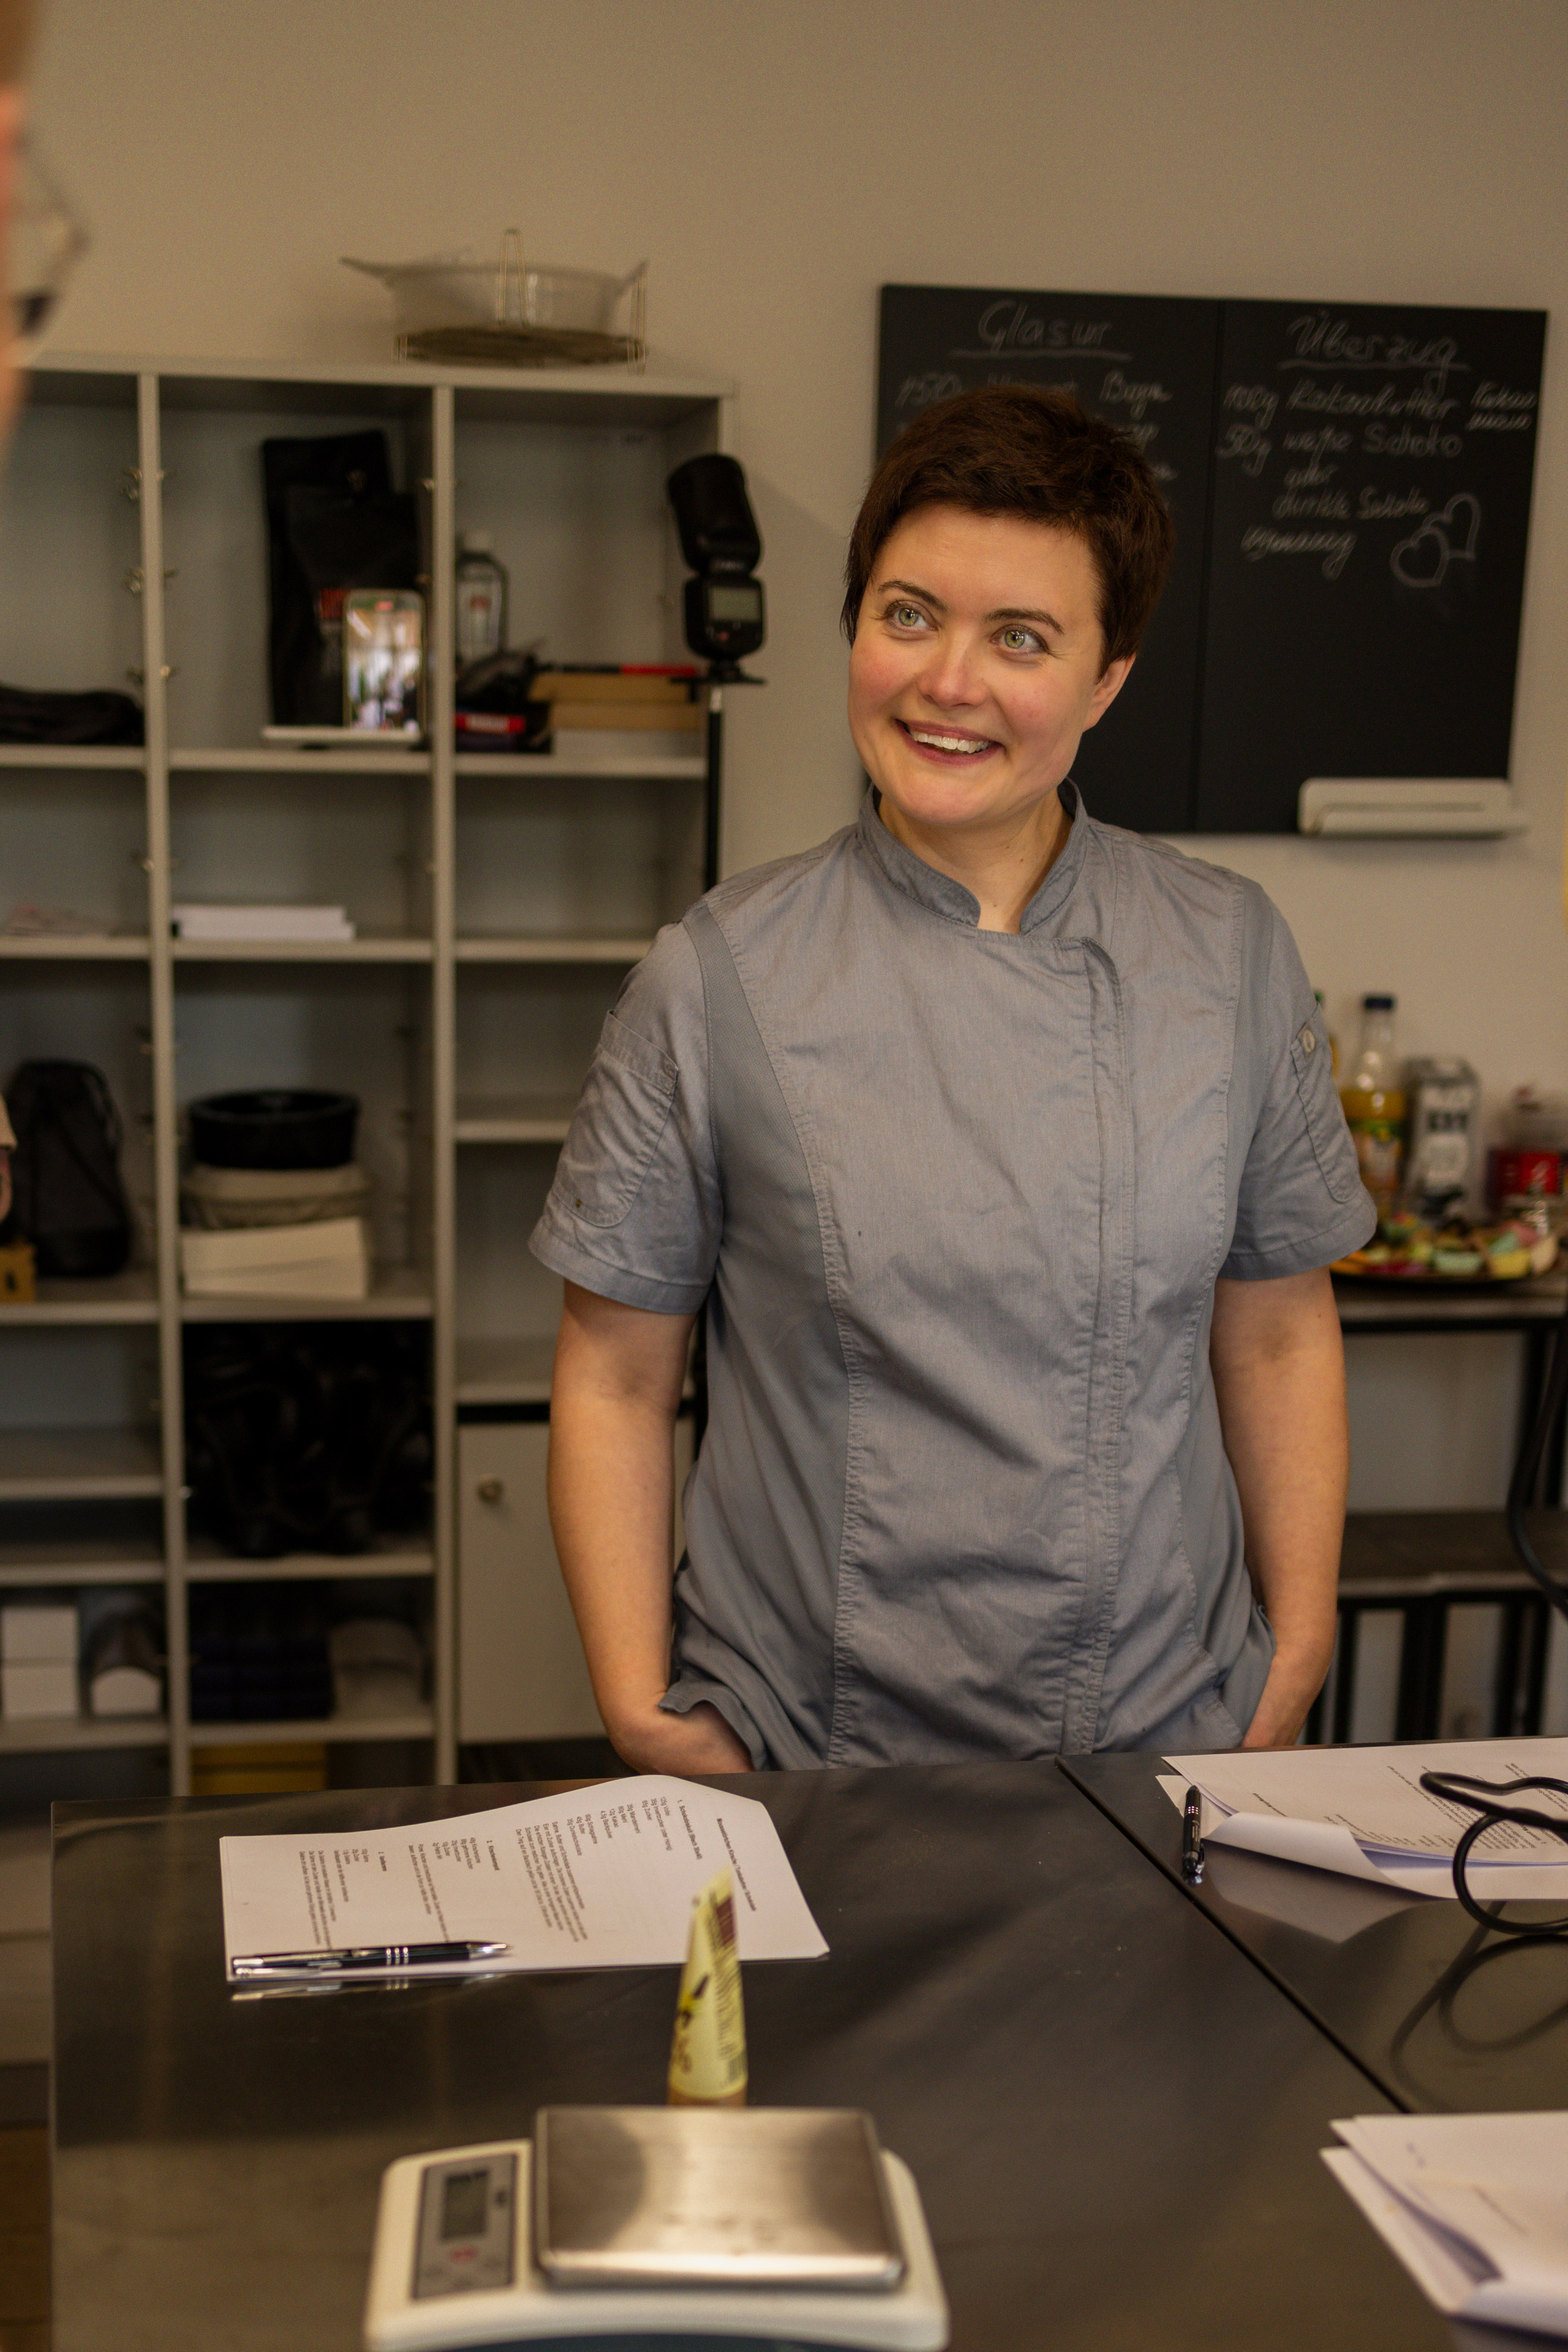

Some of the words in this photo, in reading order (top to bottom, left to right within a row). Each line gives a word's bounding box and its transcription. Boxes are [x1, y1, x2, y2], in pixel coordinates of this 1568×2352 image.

[978, 300, 1114, 355] Glasur
[1288, 309, 1458, 399] Überzug
[1363, 421, 1464, 459] Schoko
[644, 1807, 652, 1820] Zucker
